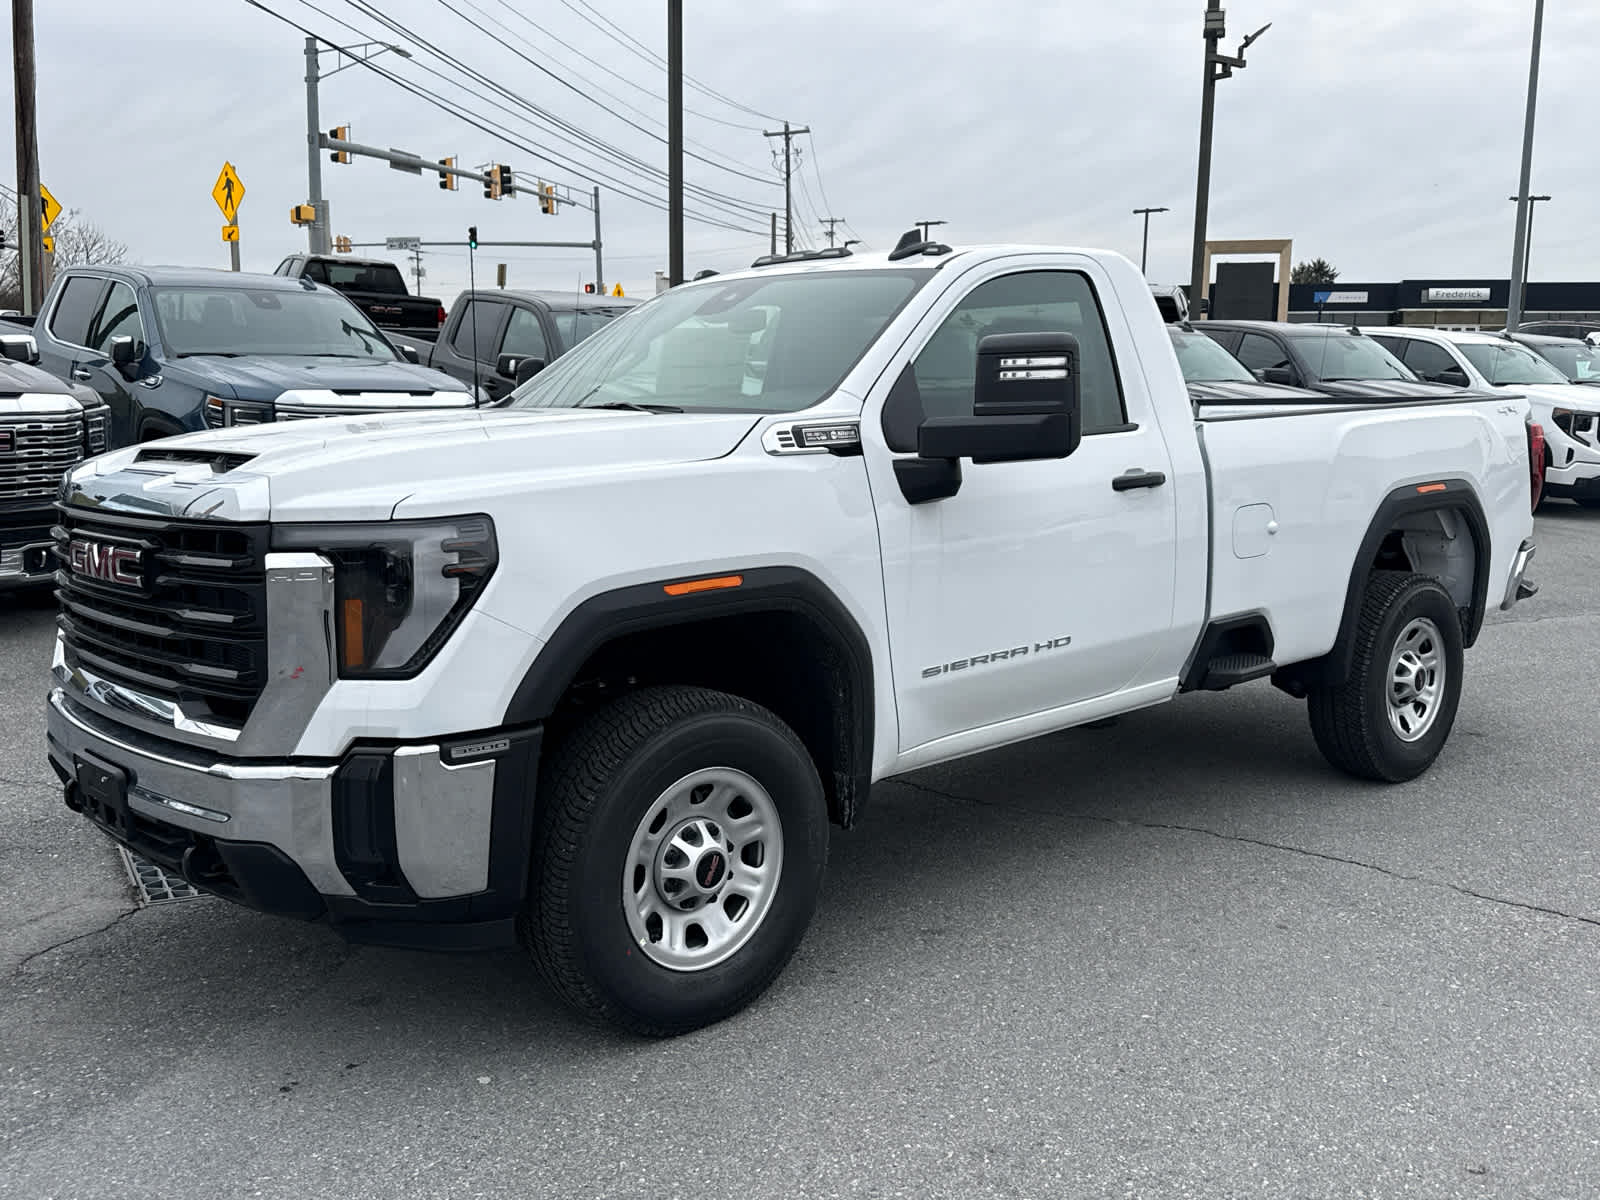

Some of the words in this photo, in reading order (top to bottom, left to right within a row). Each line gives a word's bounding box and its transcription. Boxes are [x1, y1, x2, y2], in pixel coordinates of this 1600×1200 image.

[1435, 290, 1482, 298] Frederick
[370, 305, 402, 315] GMC
[70, 540, 142, 588] GMC
[921, 646, 1029, 679] SIERRA
[1034, 636, 1072, 653] HD
[450, 739, 510, 758] 3500
[704, 855, 720, 886] GMC
